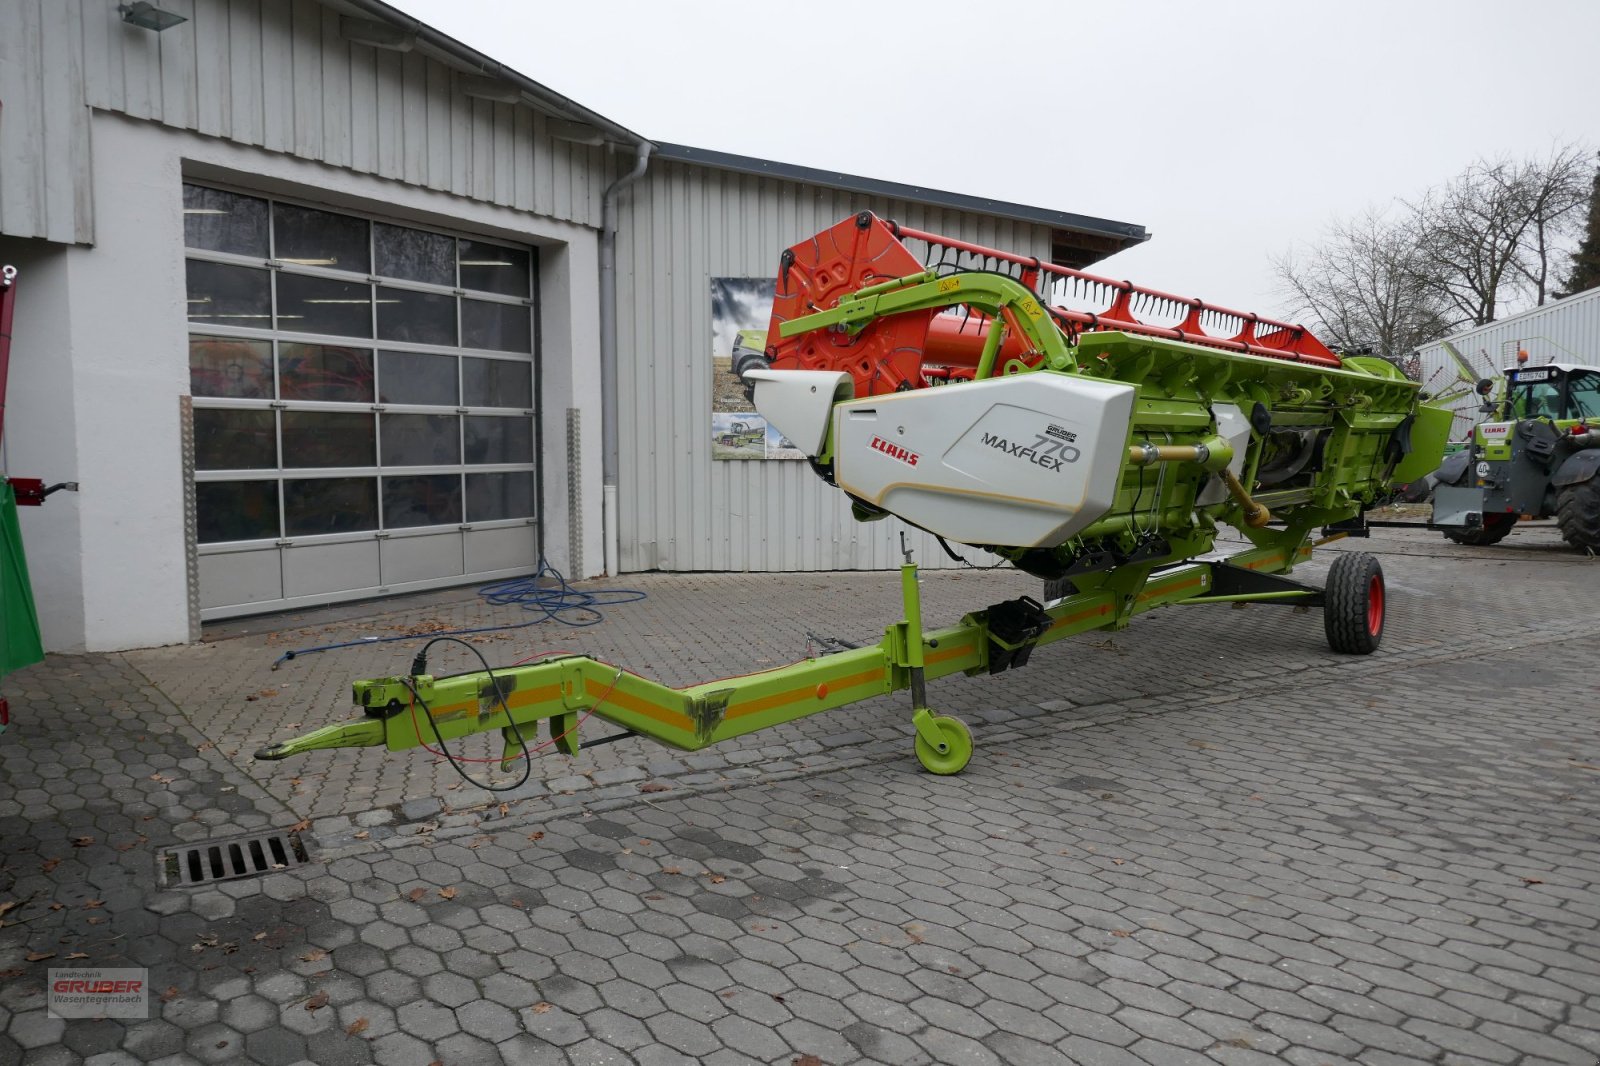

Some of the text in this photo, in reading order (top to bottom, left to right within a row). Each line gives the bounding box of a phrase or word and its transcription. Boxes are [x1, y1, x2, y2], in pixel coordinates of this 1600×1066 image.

[1047, 425, 1077, 439] GRUBER
[870, 436, 919, 466] CLAAS
[980, 432, 1064, 473] MAXFLEX
[1028, 434, 1081, 463] 770
